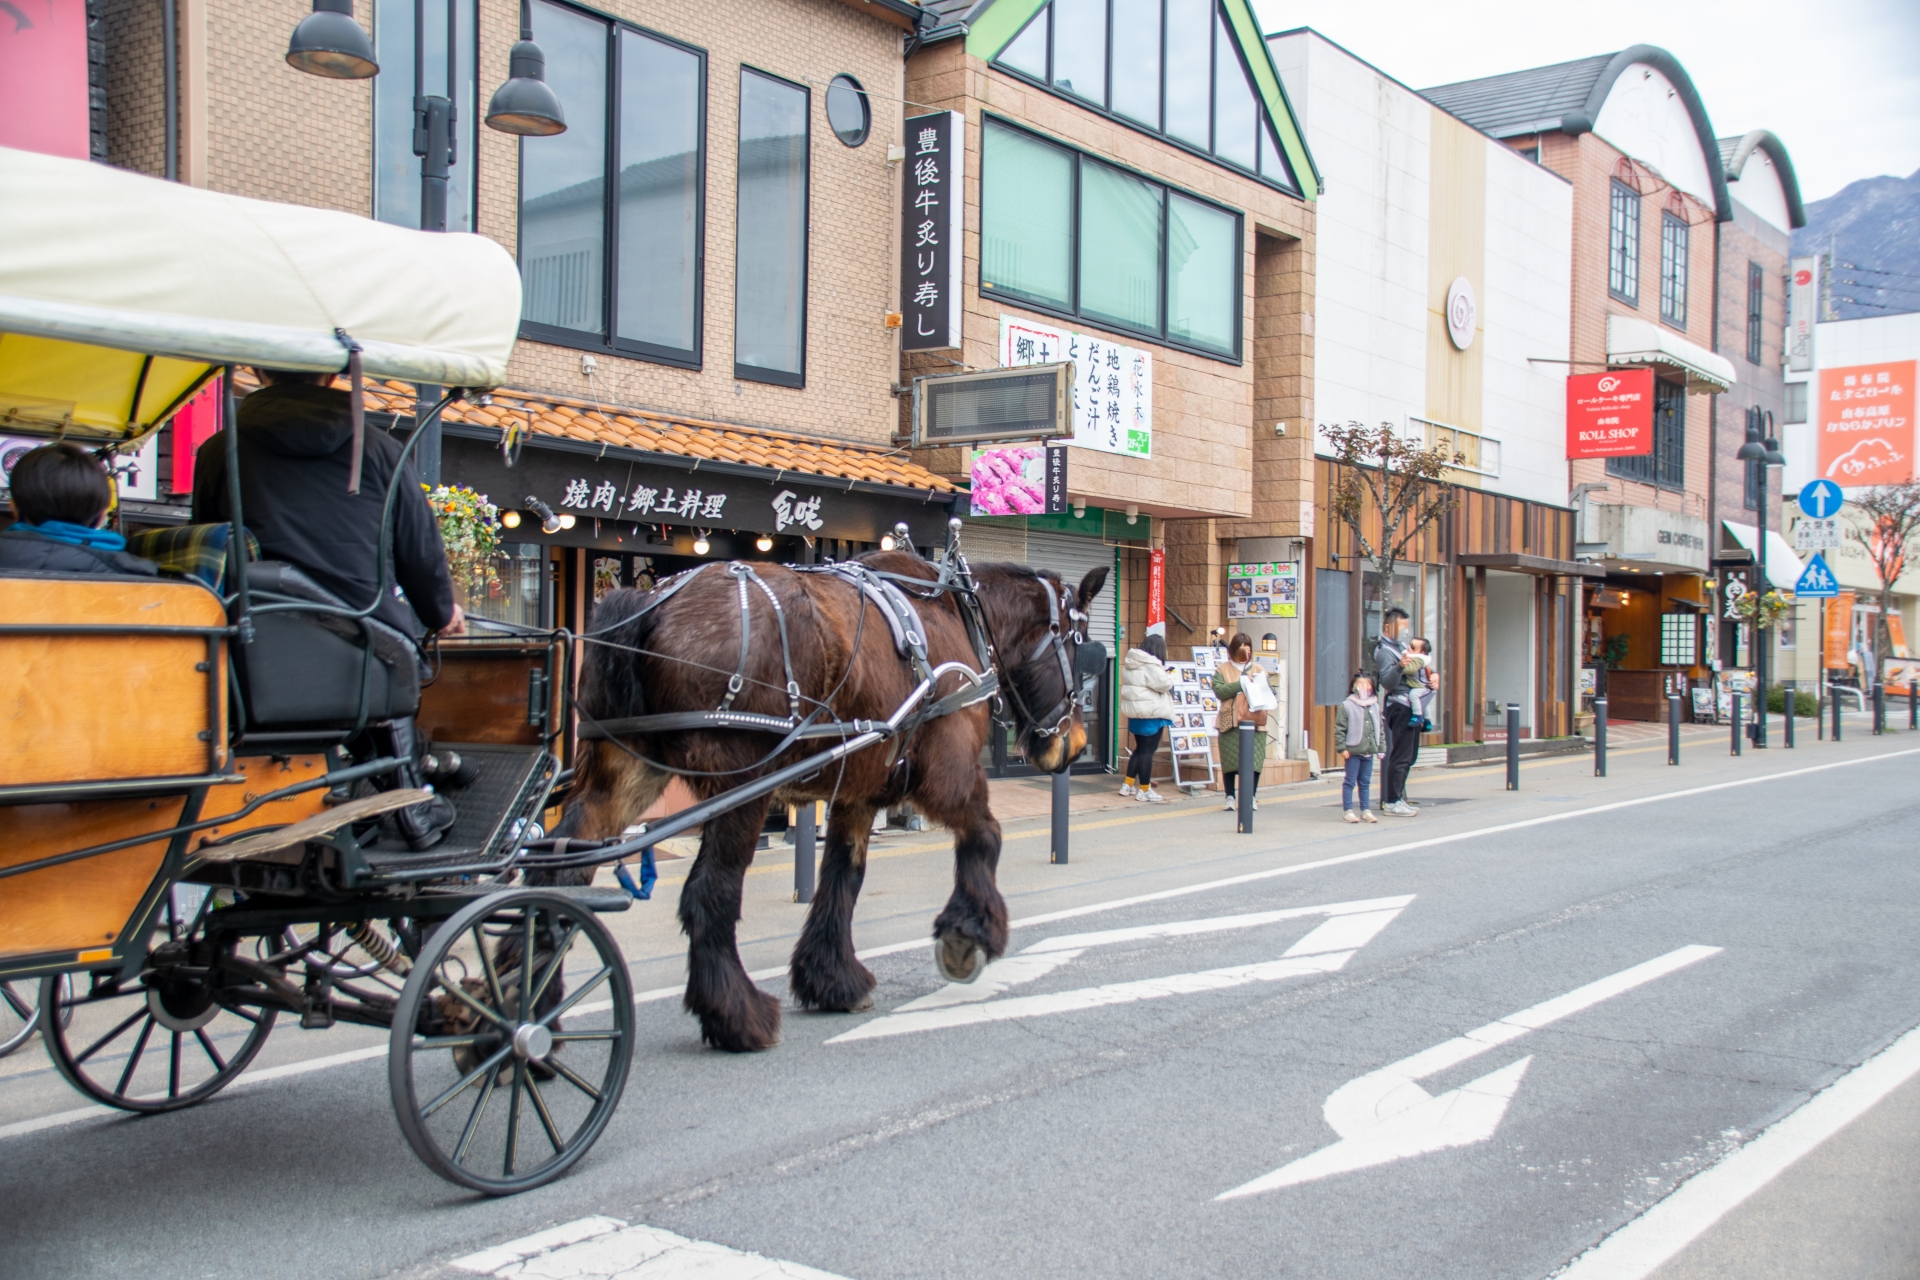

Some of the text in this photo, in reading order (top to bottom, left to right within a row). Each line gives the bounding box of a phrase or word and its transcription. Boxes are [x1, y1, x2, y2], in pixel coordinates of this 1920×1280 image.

[914, 127, 940, 337] 豊後牛炙り寿し
[1087, 341, 1100, 432] だんご汁
[1106, 348, 1121, 447] 地鶏焼き
[1579, 427, 1639, 441] ROLL SHOP
[561, 478, 727, 519] 焼肉・郷土料理
[1052, 448, 1061, 511] 豊後牛炙り寿し
[1229, 563, 1291, 575] 大分名物
